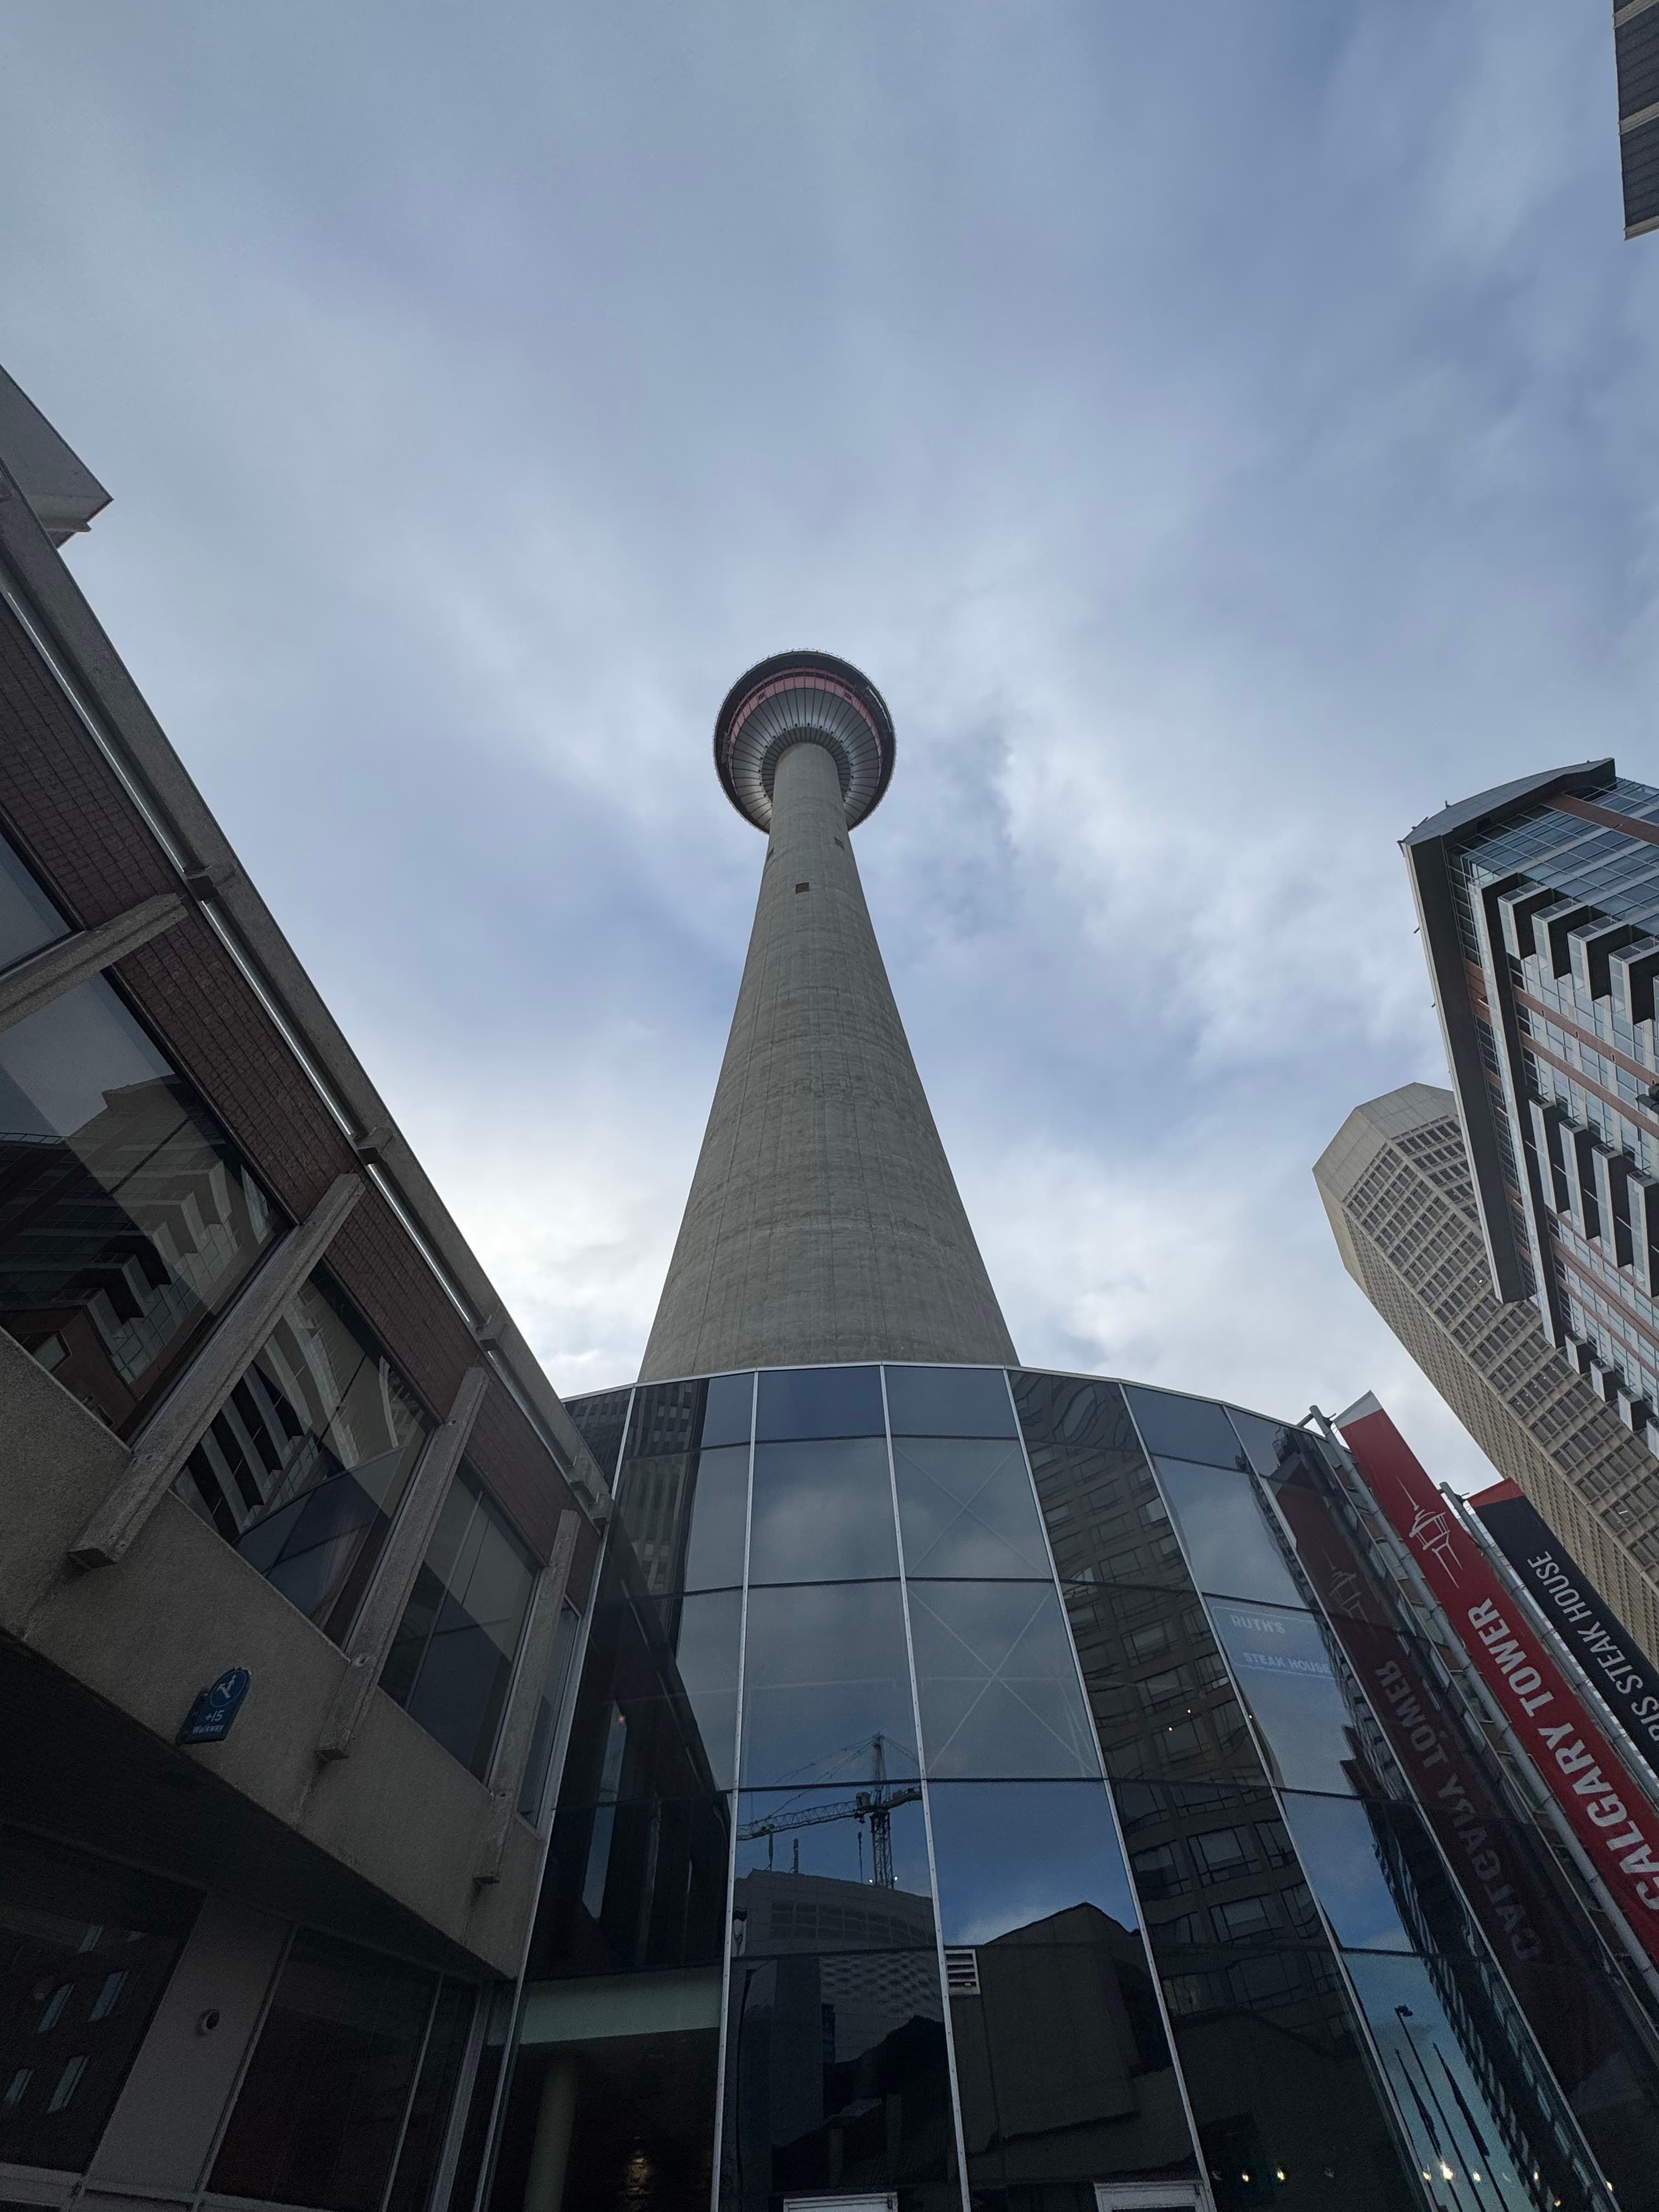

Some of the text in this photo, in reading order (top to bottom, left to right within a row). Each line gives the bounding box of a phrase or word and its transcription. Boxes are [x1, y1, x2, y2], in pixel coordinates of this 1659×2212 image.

[1527, 1551, 1593, 1622] HOUSE
[1230, 1615, 1285, 1634] RUTH'S
[1243, 1652, 1331, 1674] STEAK HOUSE
[1467, 1598, 1554, 1717] TOWER
[1577, 1621, 1644, 1694] STEAK
[206, 1710, 225, 1722] +15
